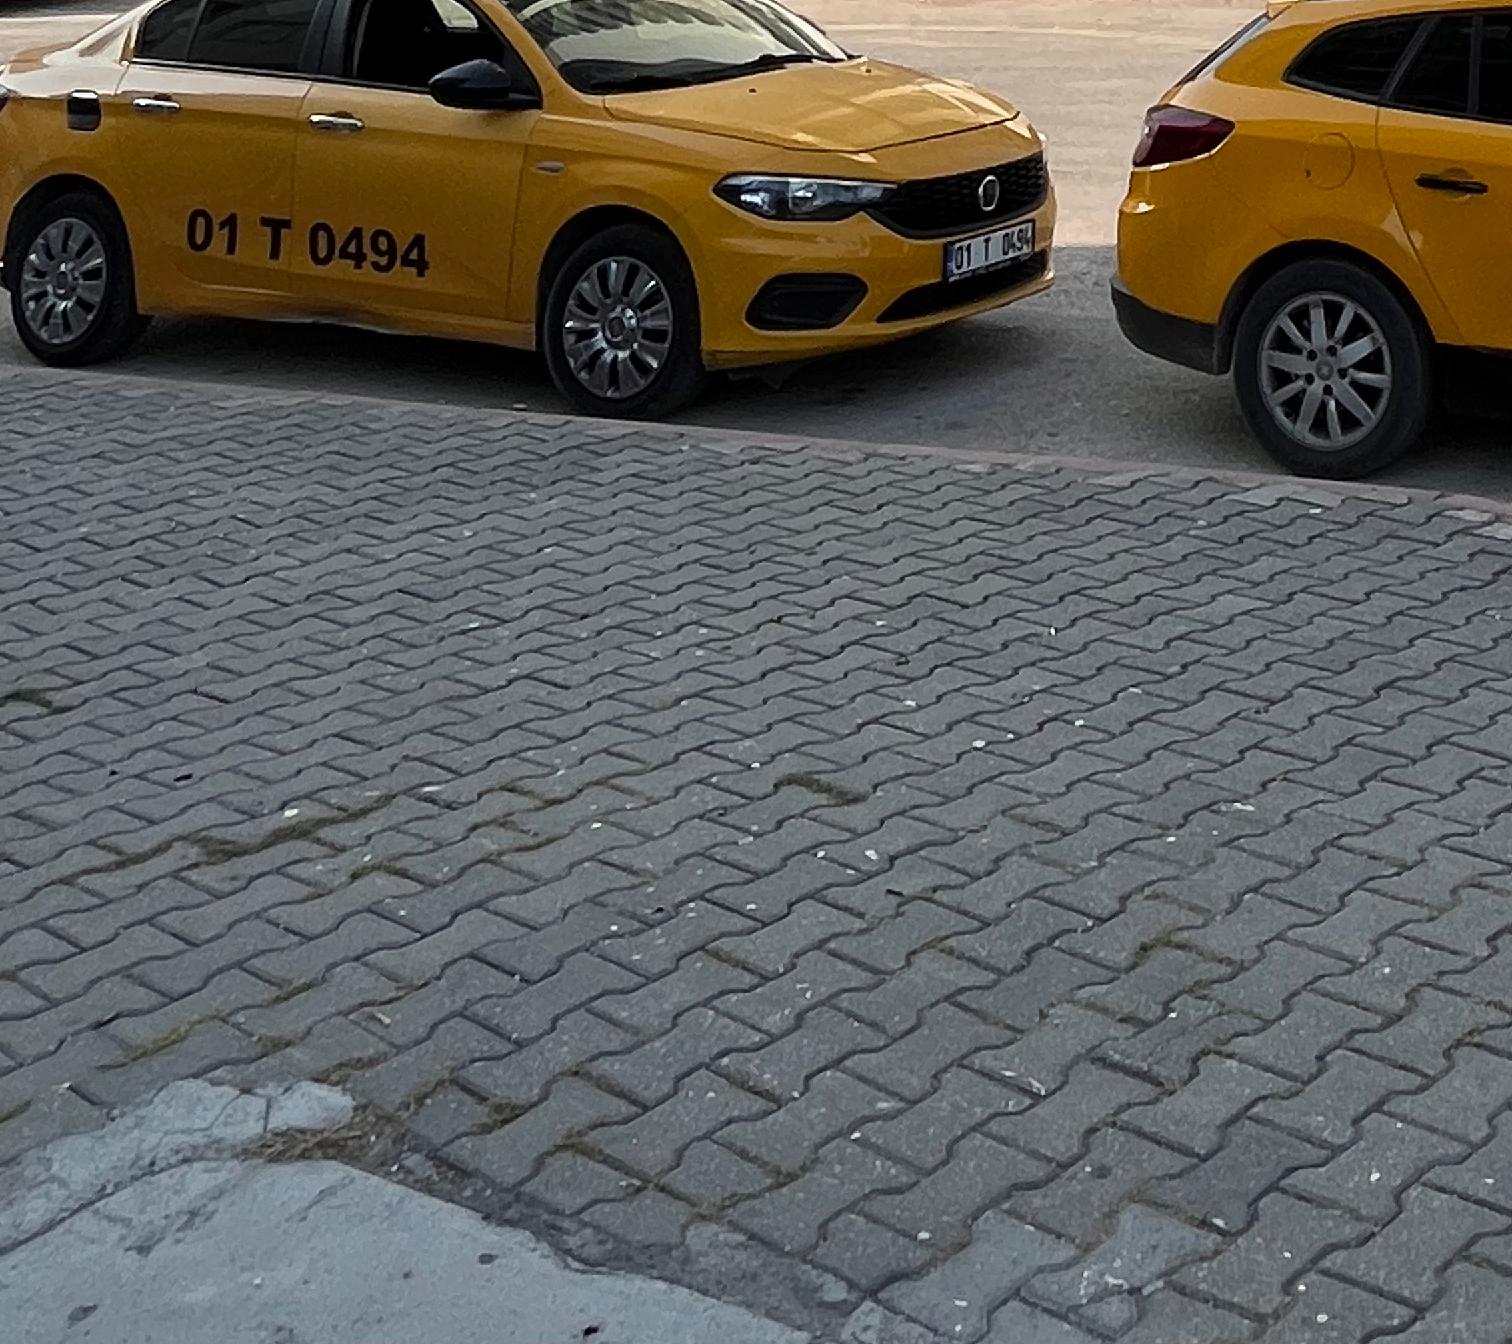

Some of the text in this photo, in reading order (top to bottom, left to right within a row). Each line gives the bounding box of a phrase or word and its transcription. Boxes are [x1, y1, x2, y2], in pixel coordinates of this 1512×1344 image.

[186, 208, 430, 278] 01 T 0494
